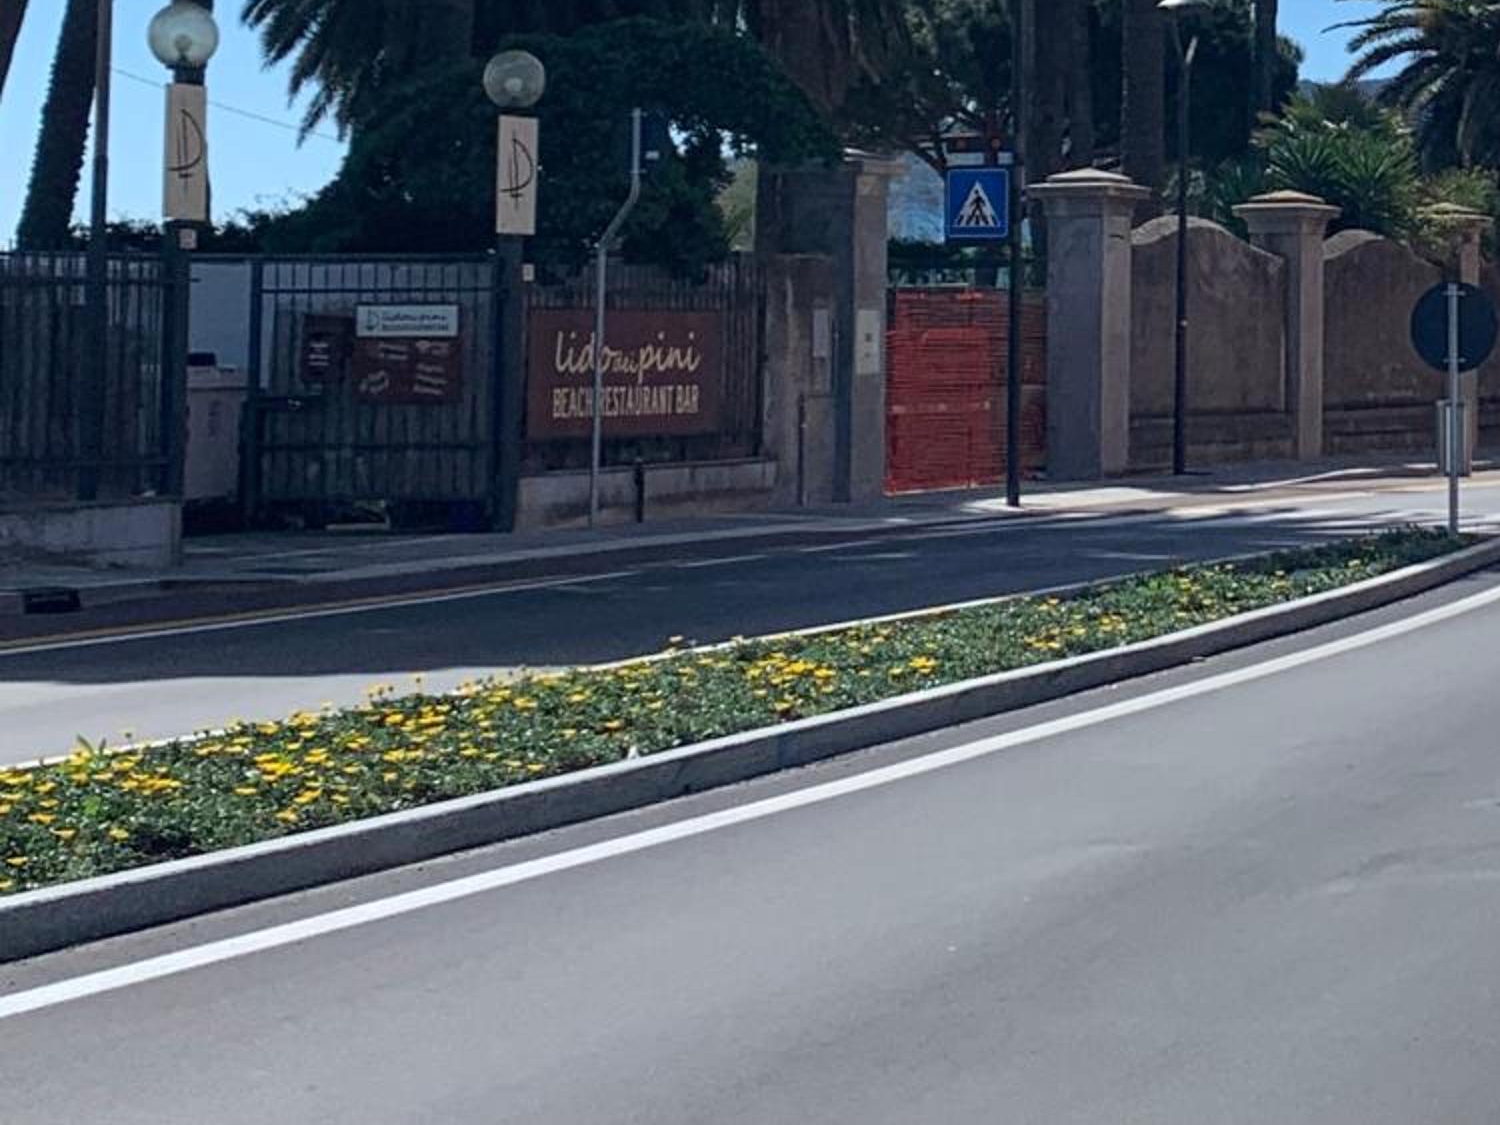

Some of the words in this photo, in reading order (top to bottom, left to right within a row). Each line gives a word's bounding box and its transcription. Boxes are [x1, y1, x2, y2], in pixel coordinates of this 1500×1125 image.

[636, 331, 701, 385] pini
[552, 386, 593, 419] BEACH
[675, 383, 699, 414] BAR
